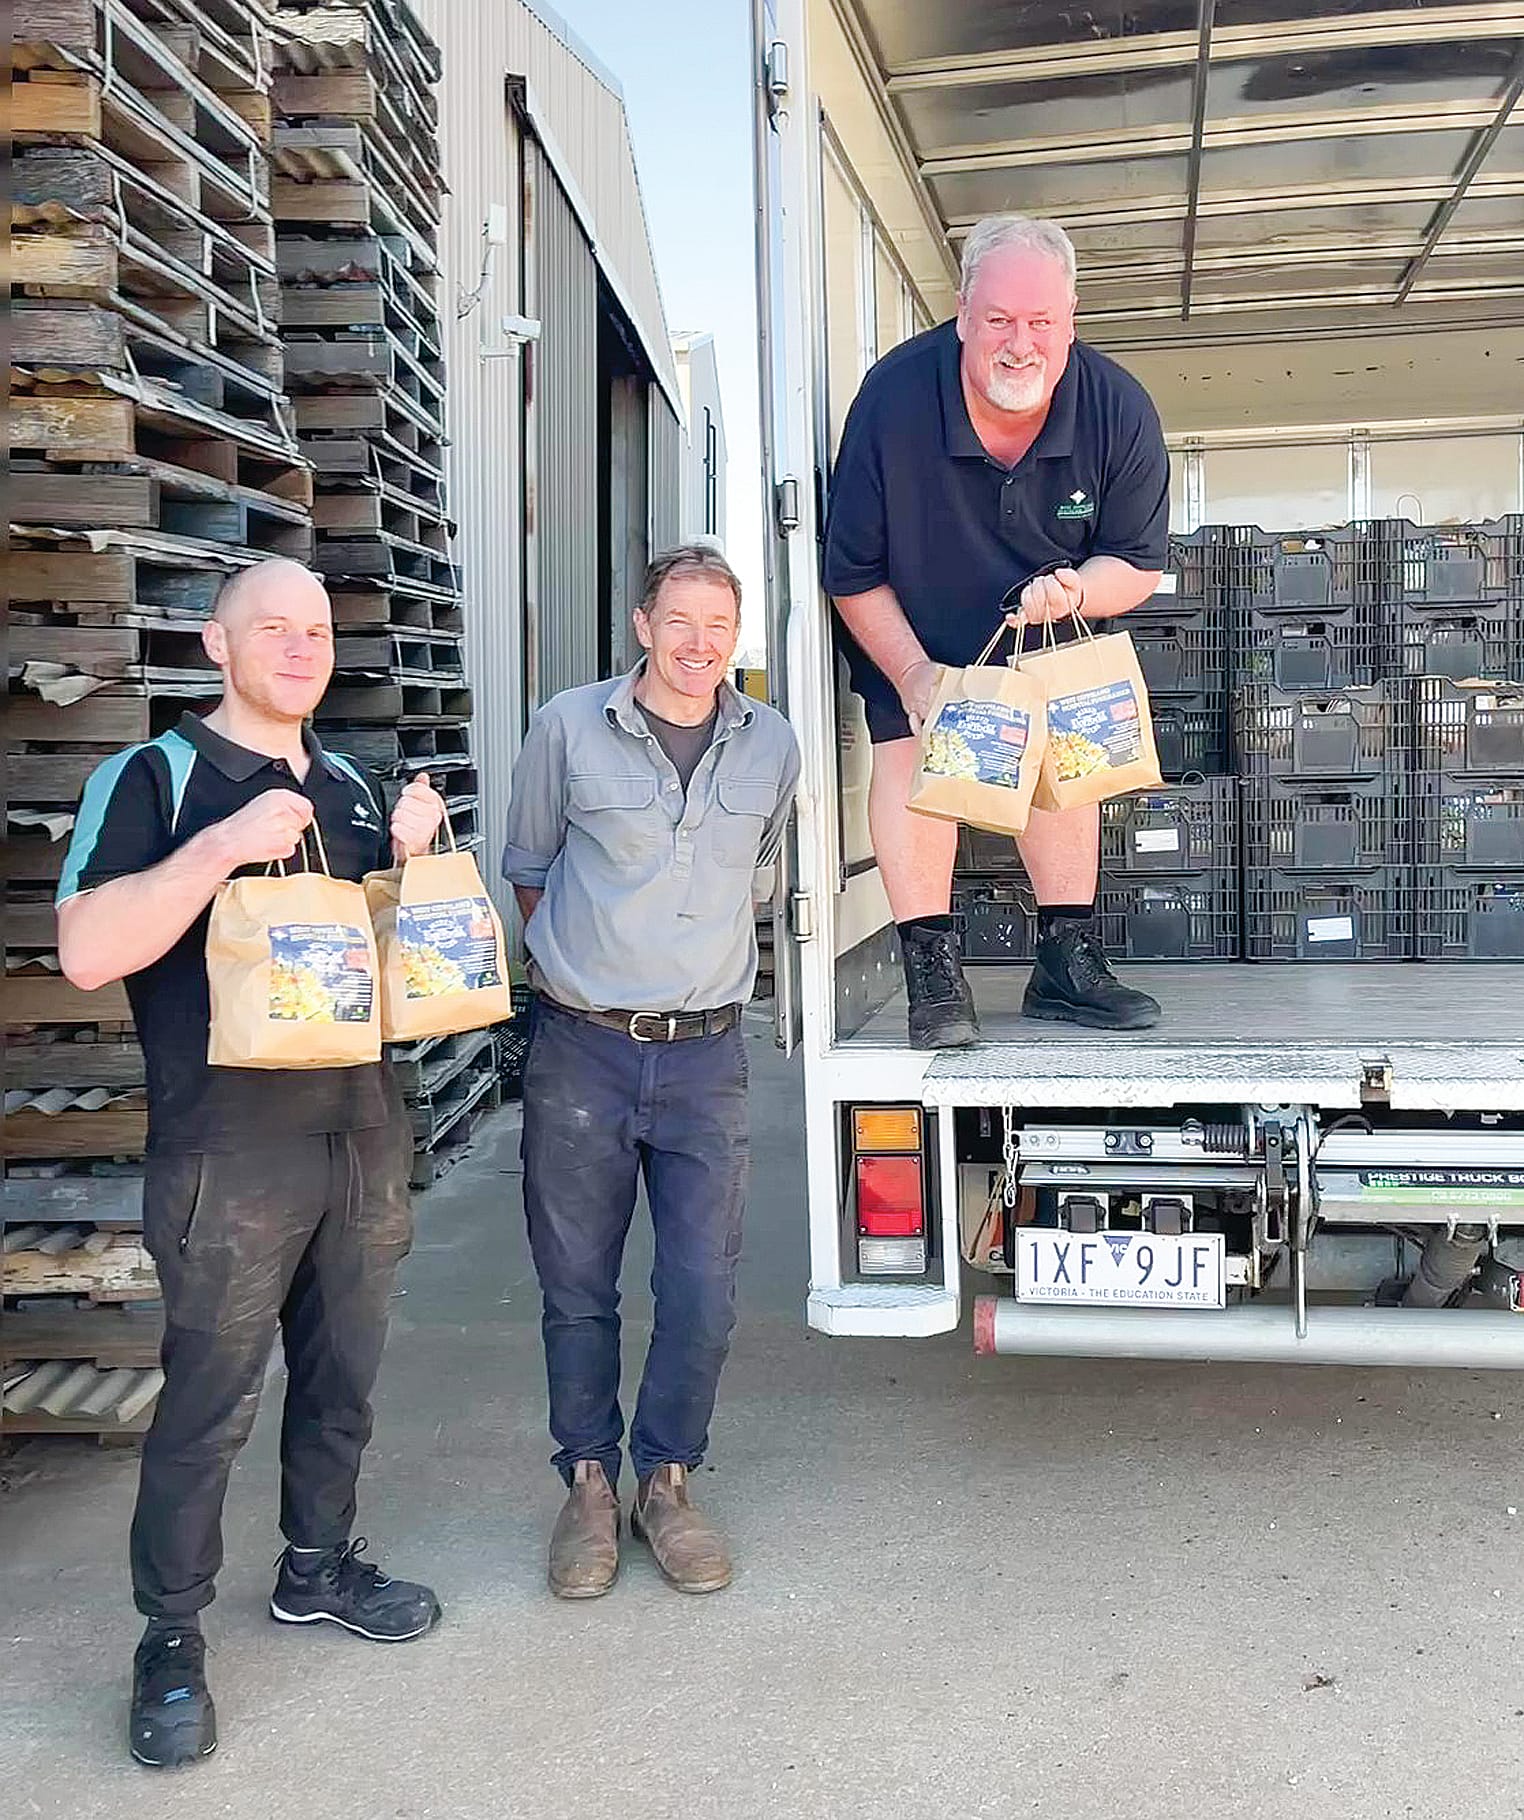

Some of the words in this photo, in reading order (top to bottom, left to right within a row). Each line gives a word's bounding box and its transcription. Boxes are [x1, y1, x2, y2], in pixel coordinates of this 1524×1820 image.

[1367, 1173, 1445, 1183] PRESTIGE
[1450, 1173, 1505, 1183] TRUCK
[1030, 1242, 1097, 1284] 1XF
[1136, 1246, 1210, 1288] 9JF
[1029, 1287, 1078, 1297] VICTORIA
[1089, 1288, 1109, 1298] THE
[1113, 1289, 1173, 1300] EDUCATION
[1177, 1291, 1209, 1301] STATE
